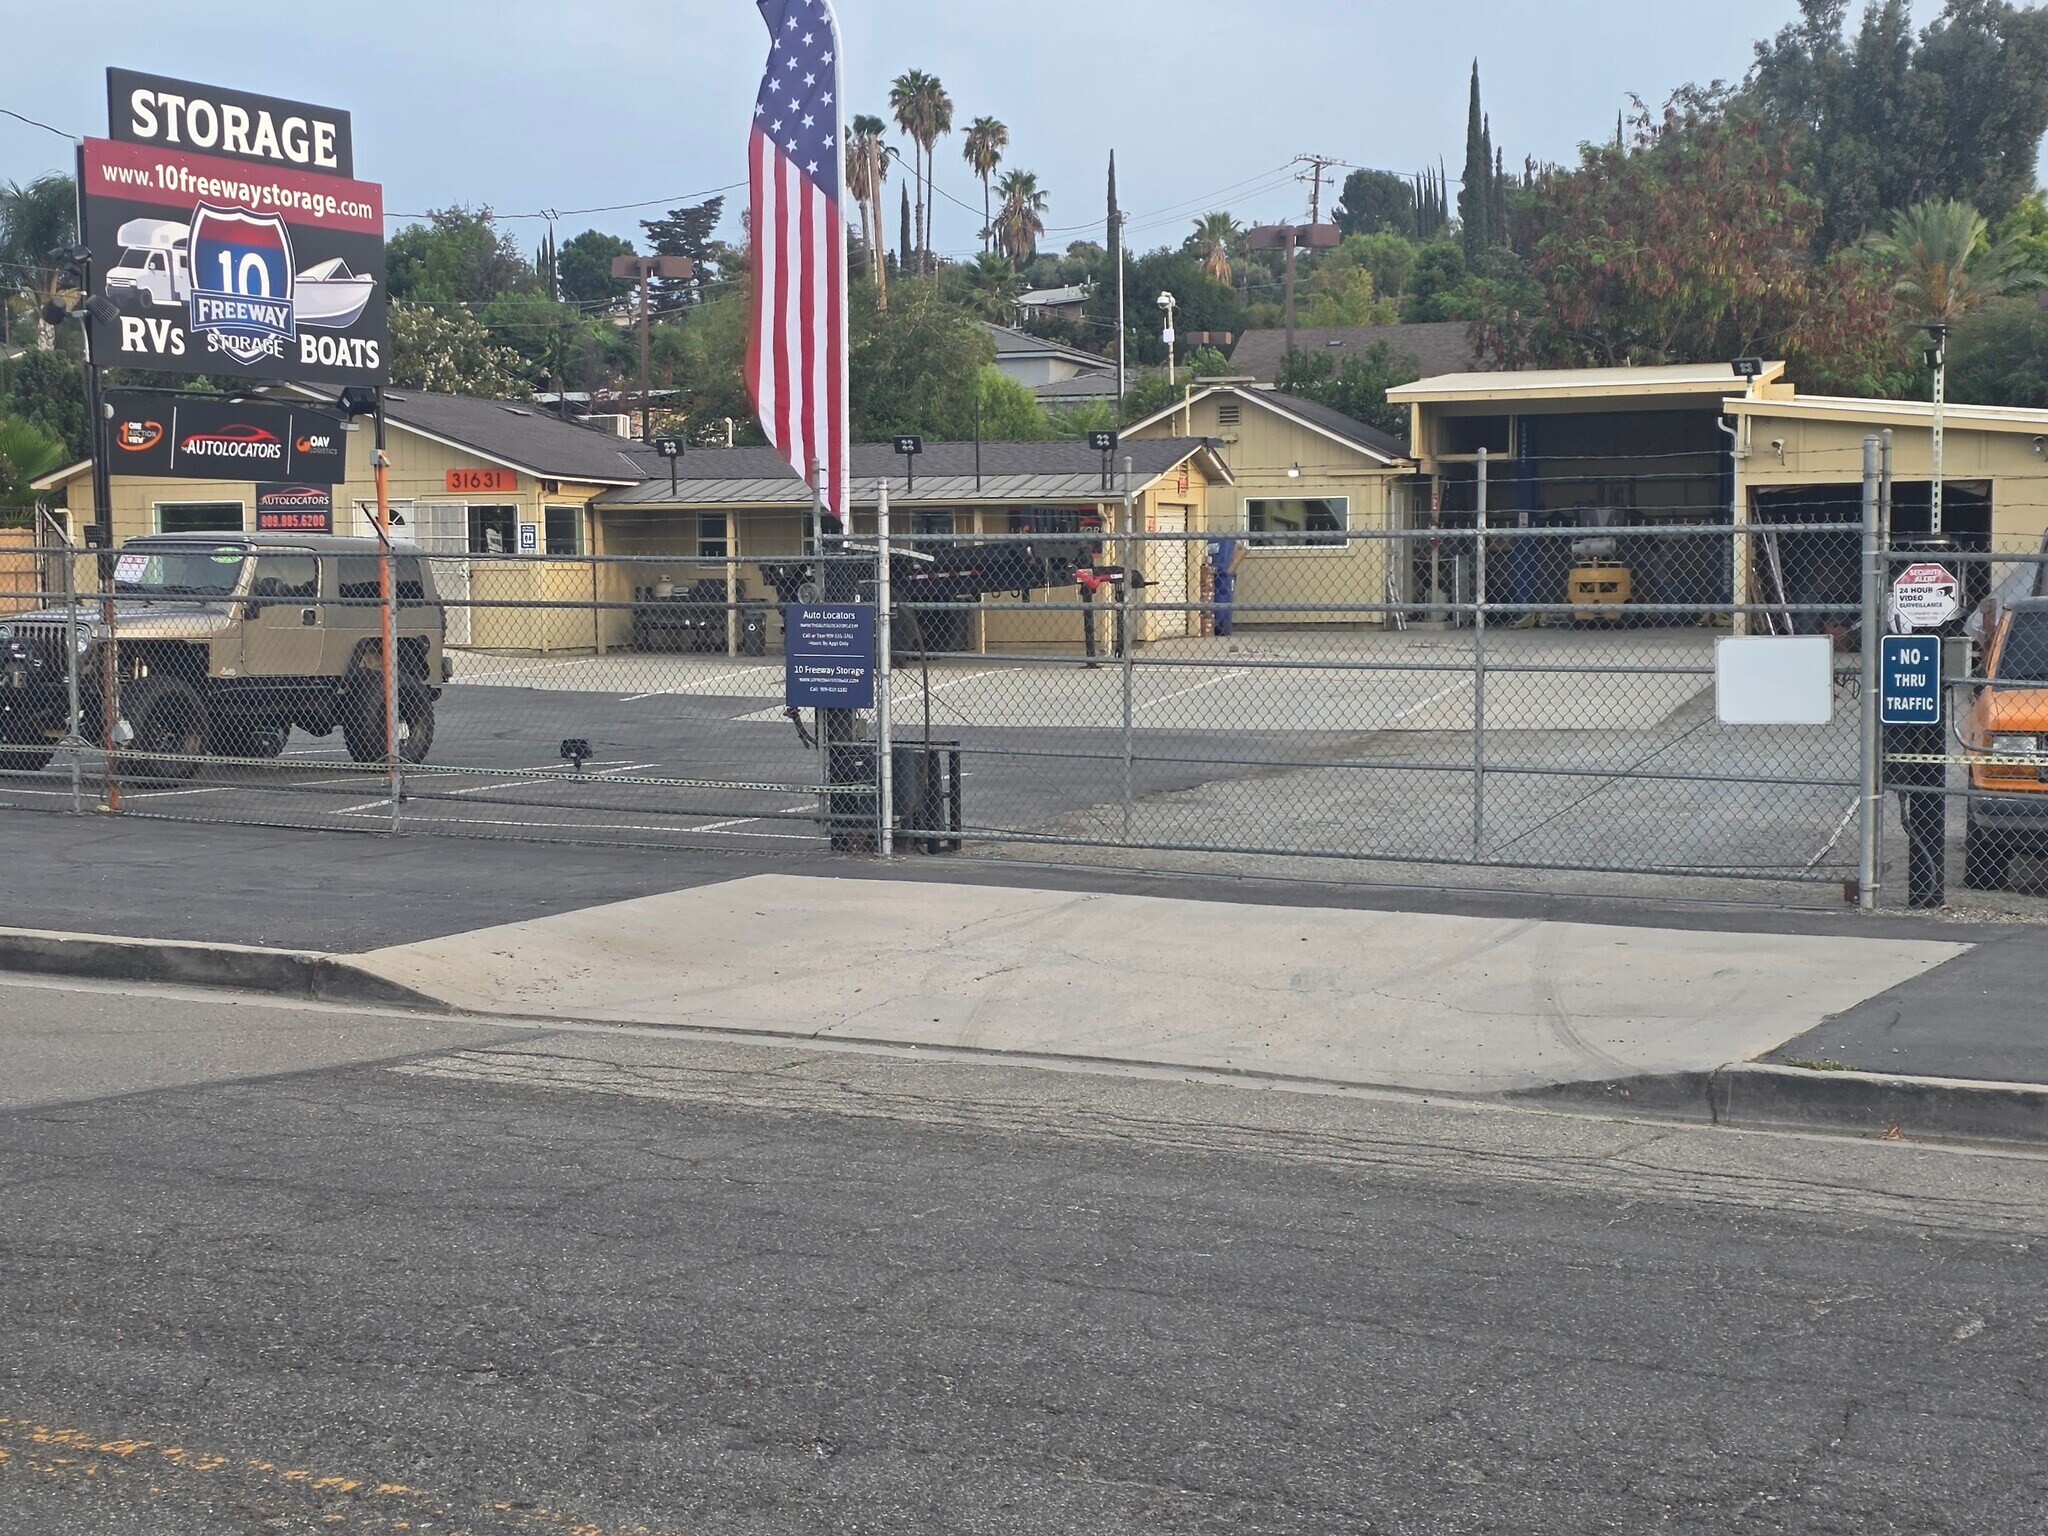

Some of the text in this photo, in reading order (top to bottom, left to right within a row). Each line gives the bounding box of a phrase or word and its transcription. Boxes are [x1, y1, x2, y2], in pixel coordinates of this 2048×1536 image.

[131, 88, 338, 168] STORAGE
[102, 163, 373, 219] www.10freewaystorage.com
[218, 250, 270, 297] 10
[198, 298, 289, 330] FREEWAY
[119, 316, 186, 356] RVs
[207, 332, 285, 360] STORAGE
[300, 333, 380, 370] BOATS
[128, 422, 143, 430] ONE
[128, 430, 157, 438] AUCTION
[128, 436, 145, 444] VIEW
[310, 435, 331, 448] OAV
[187, 439, 282, 459] AUTOLOCATORS
[310, 447, 338, 456] LOGISTICS
[452, 472, 501, 489] 31631
[261, 496, 330, 505] AUTOLOCATORS
[261, 514, 325, 528] 909.985.6200
[1899, 594, 1924, 602] VIDEO
[803, 610, 856, 620] Auto Locators
[1900, 648, 1921, 665] NO
[794, 665, 865, 677] 10 Freeway Storage
[1894, 674, 1926, 687] THRU
[1886, 696, 1934, 711] TRAFFIC
